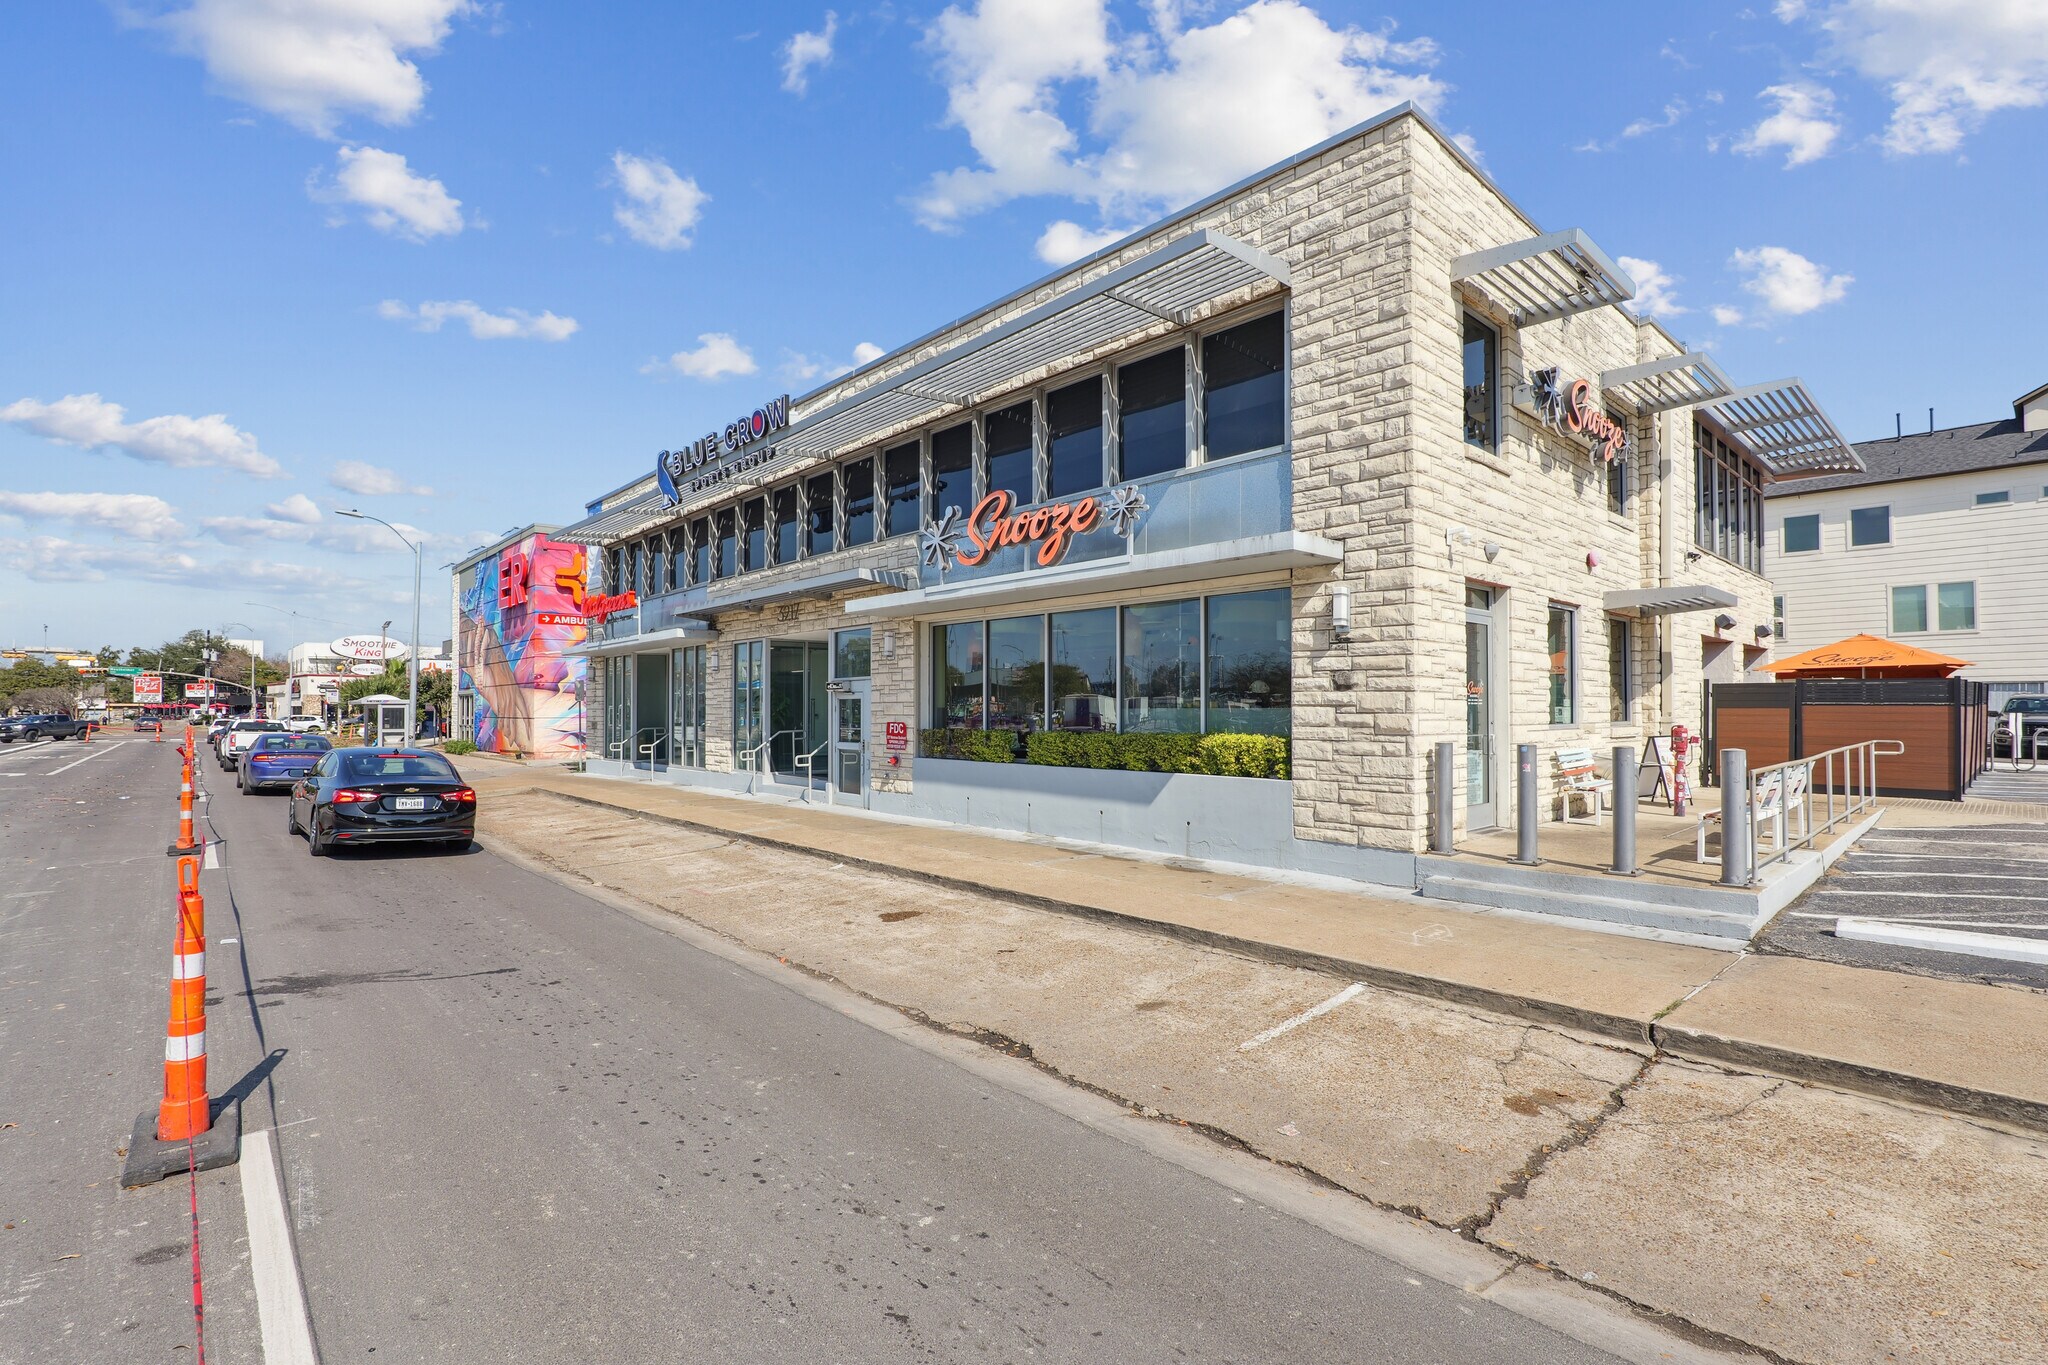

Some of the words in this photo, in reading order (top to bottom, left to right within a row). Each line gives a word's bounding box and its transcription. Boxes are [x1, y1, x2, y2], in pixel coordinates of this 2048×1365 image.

[672, 432, 719, 477] BLUE
[724, 394, 789, 451] CROW
[1562, 378, 1624, 462] Snooze
[690, 467, 730, 492] SPORTS
[733, 446, 777, 472] GROUP
[957, 489, 1104, 566] Snooze
[498, 552, 528, 609] ER
[342, 638, 397, 649] SMOOTHIE
[1802, 653, 1894, 666] Snooze
[889, 723, 904, 734] FDC
